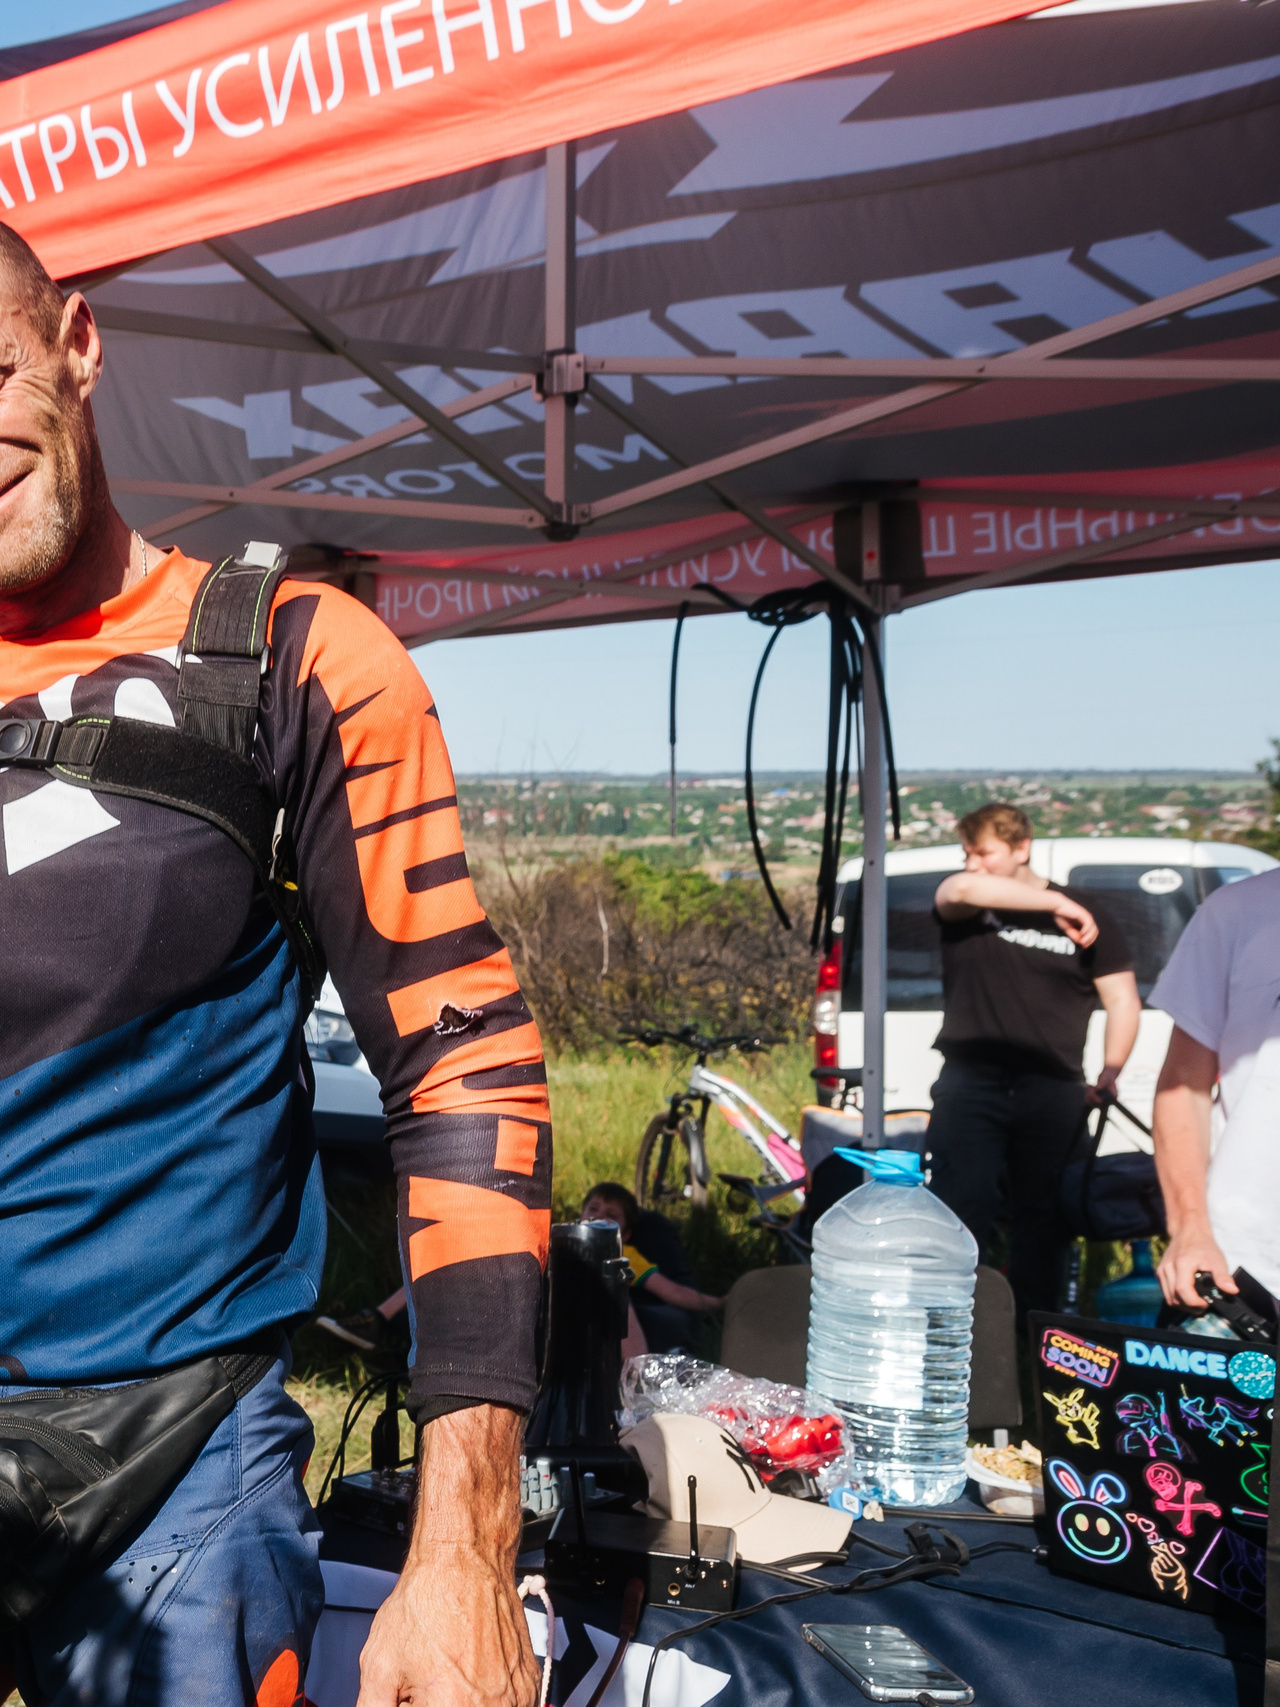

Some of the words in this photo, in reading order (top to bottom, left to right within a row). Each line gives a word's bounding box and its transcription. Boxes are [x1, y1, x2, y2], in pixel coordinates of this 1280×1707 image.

[1046, 1346, 1109, 1383] SOON
[1050, 1335, 1111, 1368] COMING
[1124, 1339, 1229, 1380] DANCE
